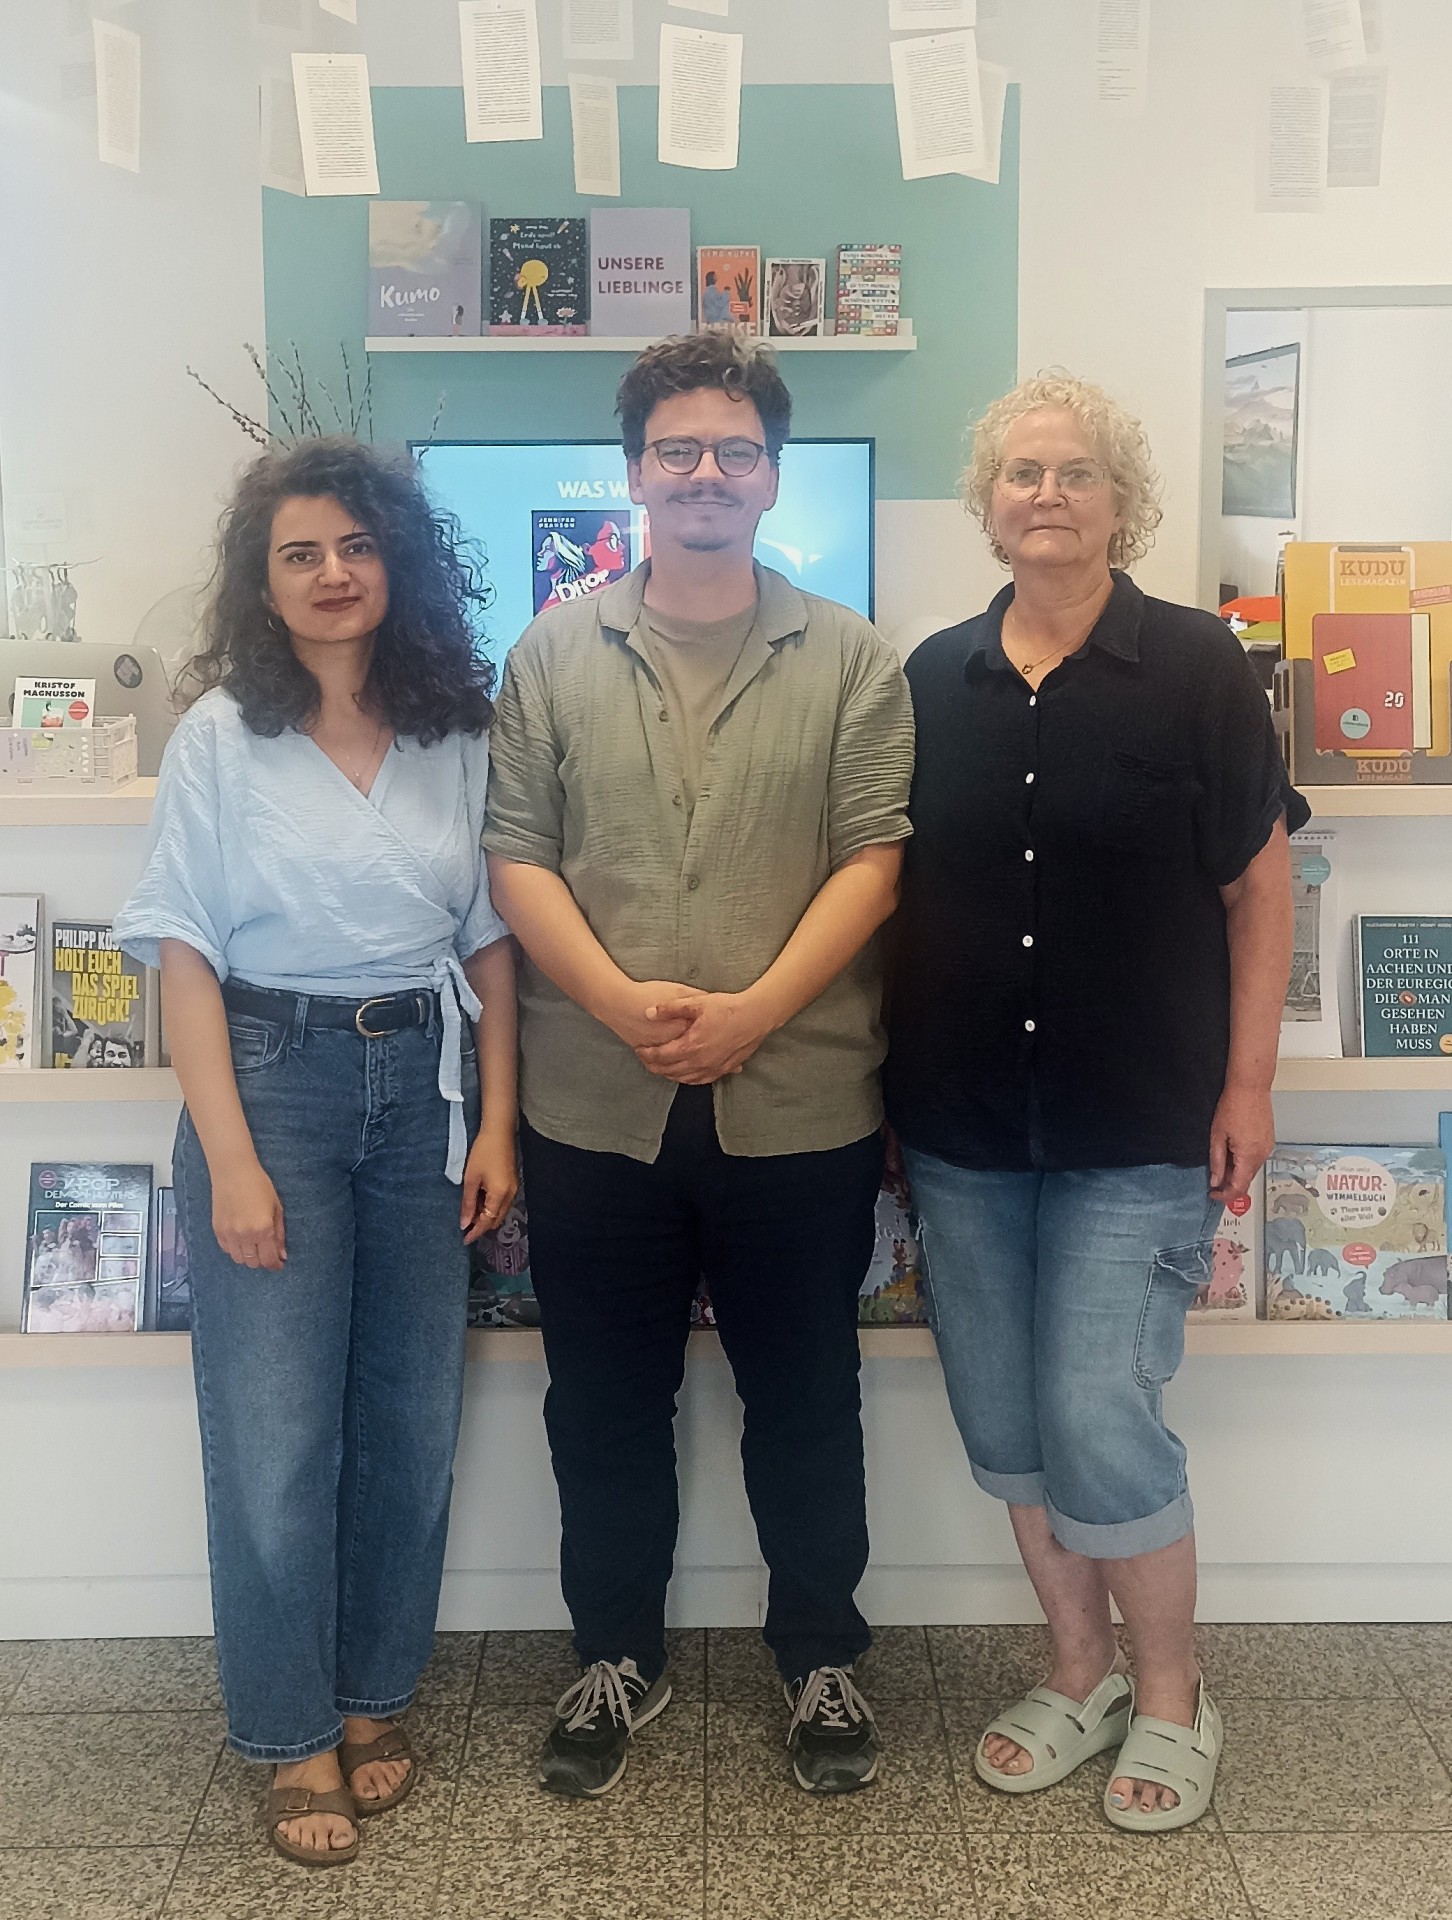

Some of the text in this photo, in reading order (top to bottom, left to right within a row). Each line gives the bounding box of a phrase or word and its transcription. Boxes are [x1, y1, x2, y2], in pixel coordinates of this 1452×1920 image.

[598, 257, 664, 270] UNSERE
[598, 280, 684, 294] LIEBLINGE
[380, 285, 441, 308] Kumo
[557, 480, 606, 499] WAS
[1339, 560, 1406, 576] KUDU
[555, 568, 610, 602] DROP
[34, 681, 76, 690] KRISTOF
[23, 690, 86, 698] MAGNUSSON
[1384, 691, 1404, 708] 20
[1357, 759, 1411, 773] KUDU
[55, 929, 96, 949] PHILIPP
[1402, 934, 1420, 944] 111
[1383, 948, 1439, 959] ORTE IN
[55, 948, 122, 975] HOLT EUCH
[1366, 963, 1424, 974] AACHEN
[72, 972, 140, 1000] DAS SPIEL
[1366, 978, 1394, 989] DER
[1375, 993, 1451, 1004] DIE MAN
[72, 996, 130, 1026] ZURÜCK!
[1381, 1008, 1445, 1019] GESEHEN
[1390, 1023, 1438, 1034] HABEN
[1396, 1038, 1432, 1050] MUSS
[1326, 1174, 1387, 1191] NATUR-
[1326, 1193, 1386, 1202] WIMMELBUCH
